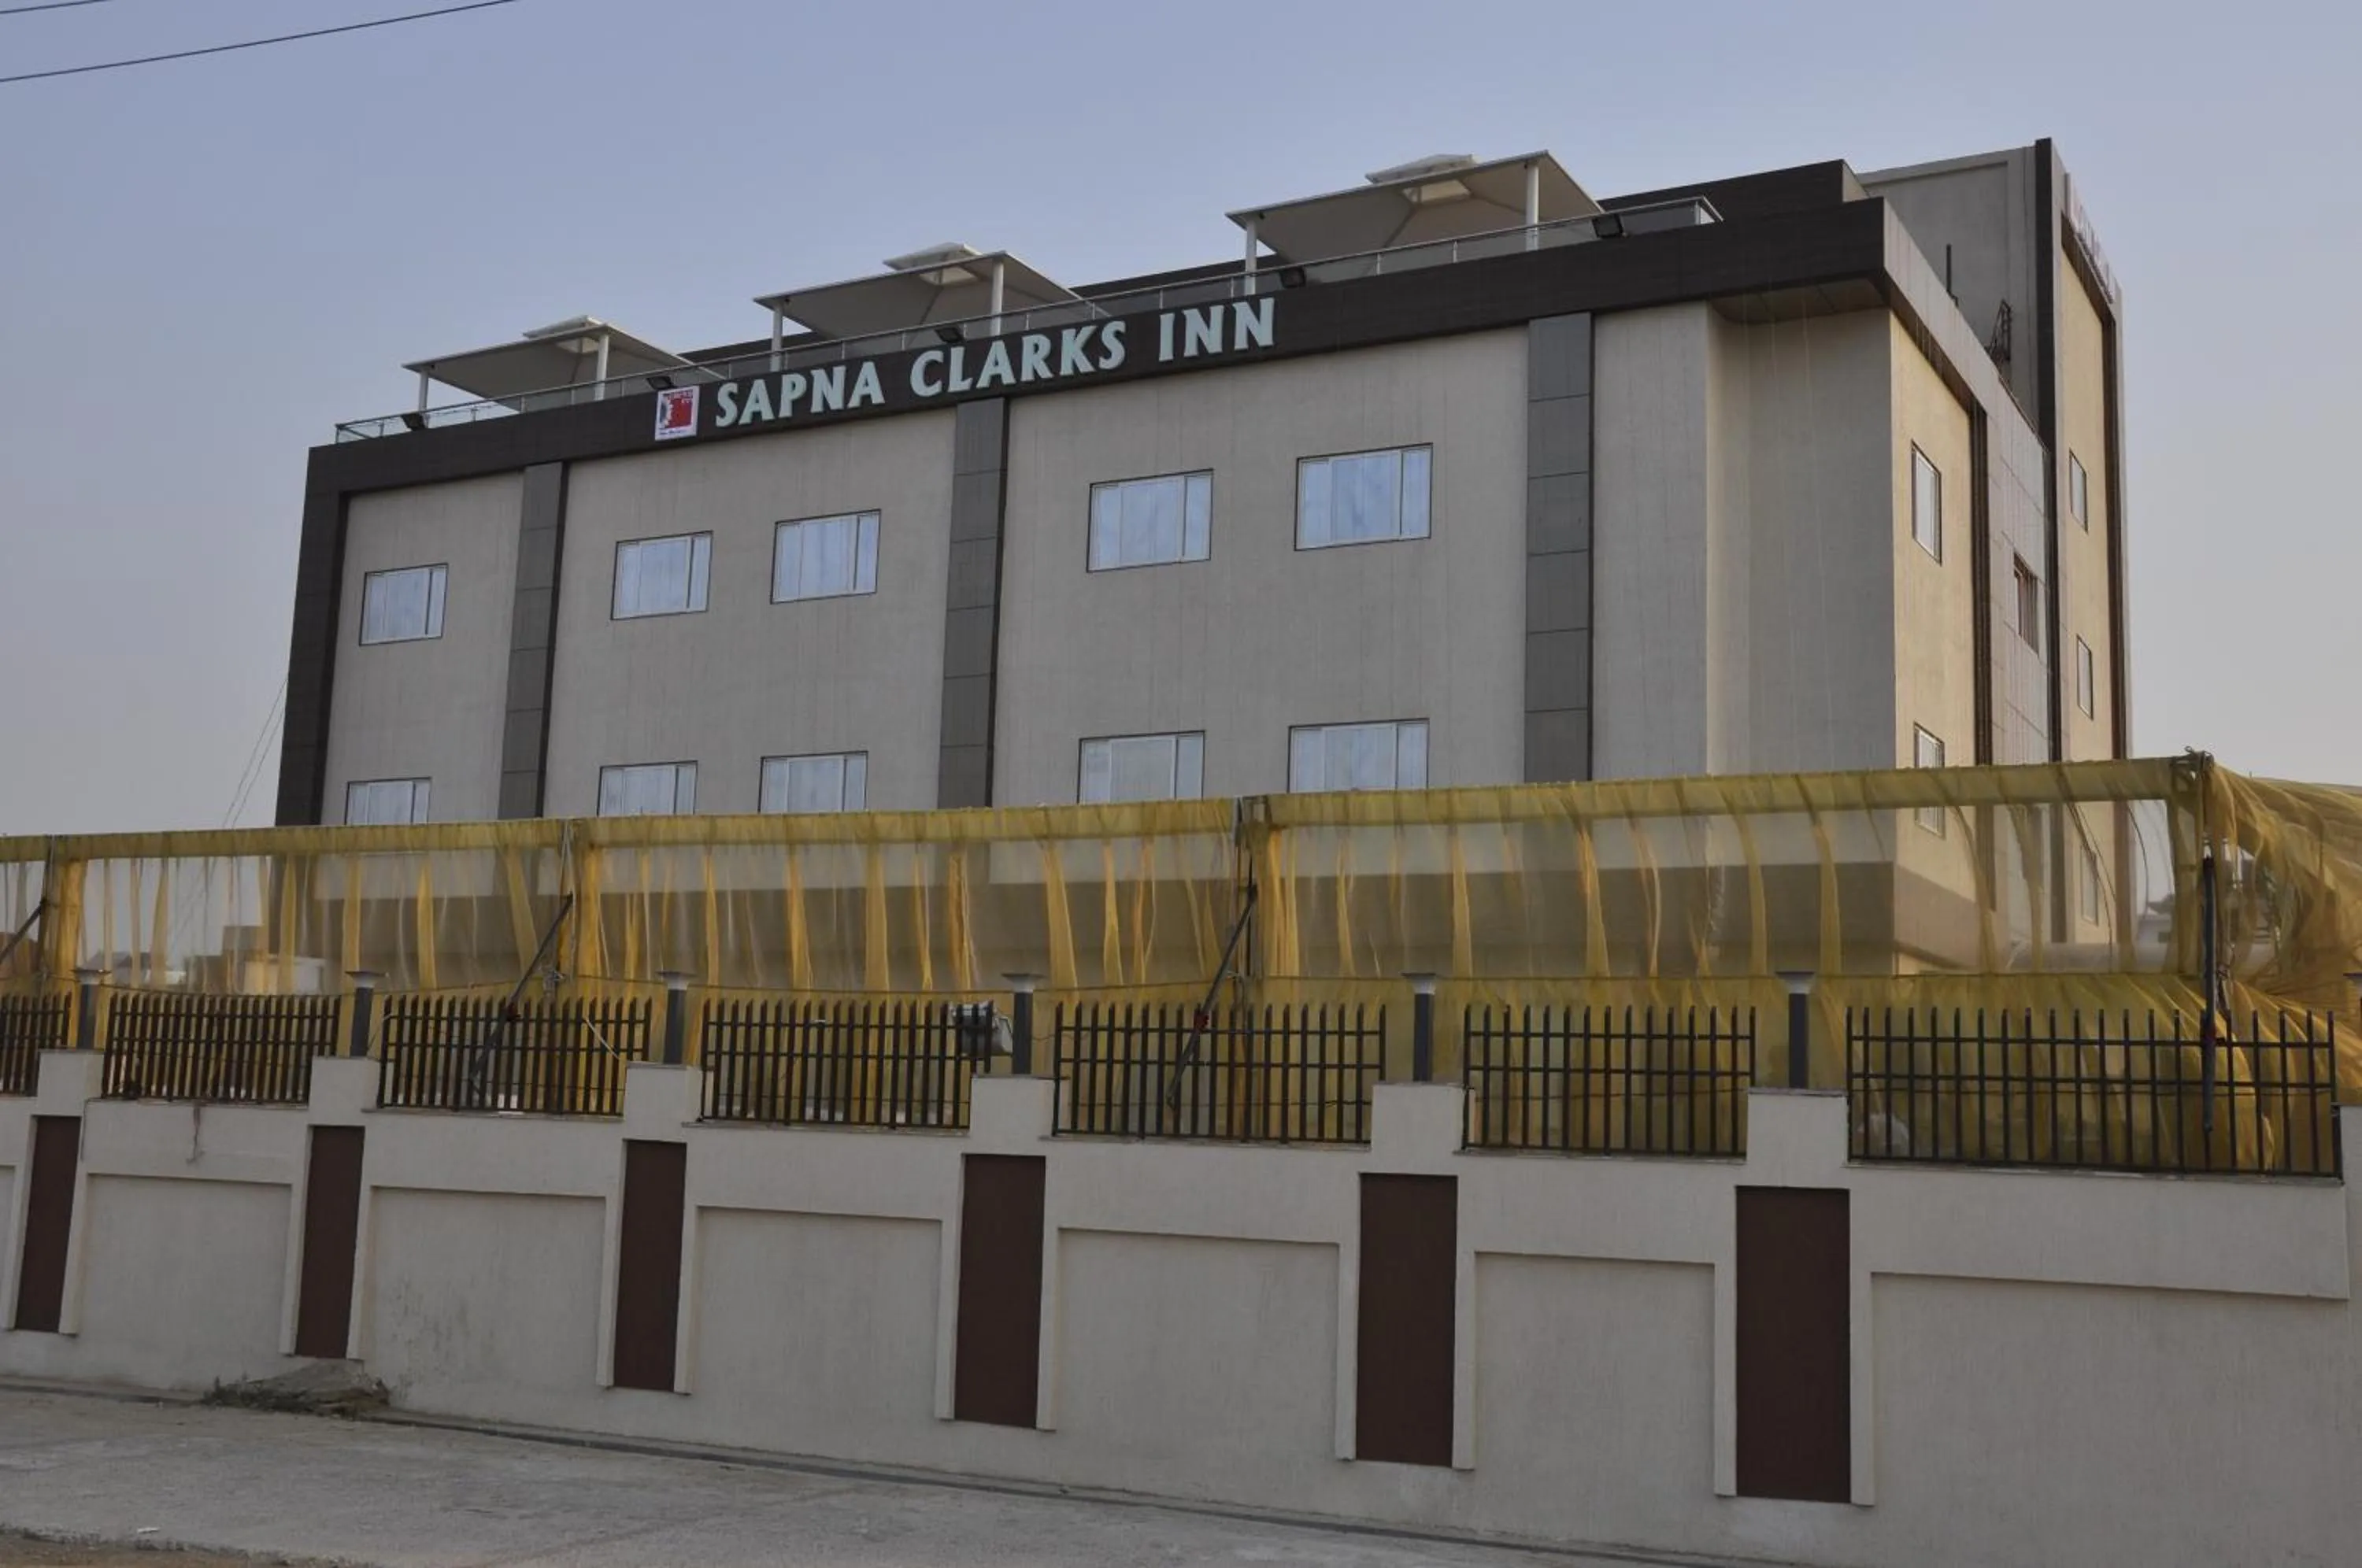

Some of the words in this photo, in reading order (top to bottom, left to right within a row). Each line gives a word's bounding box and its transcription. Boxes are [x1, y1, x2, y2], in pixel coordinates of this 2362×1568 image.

[716, 361, 884, 427] SAPNA
[911, 321, 1126, 397] CLARKS
[1160, 298, 1275, 361] INN
